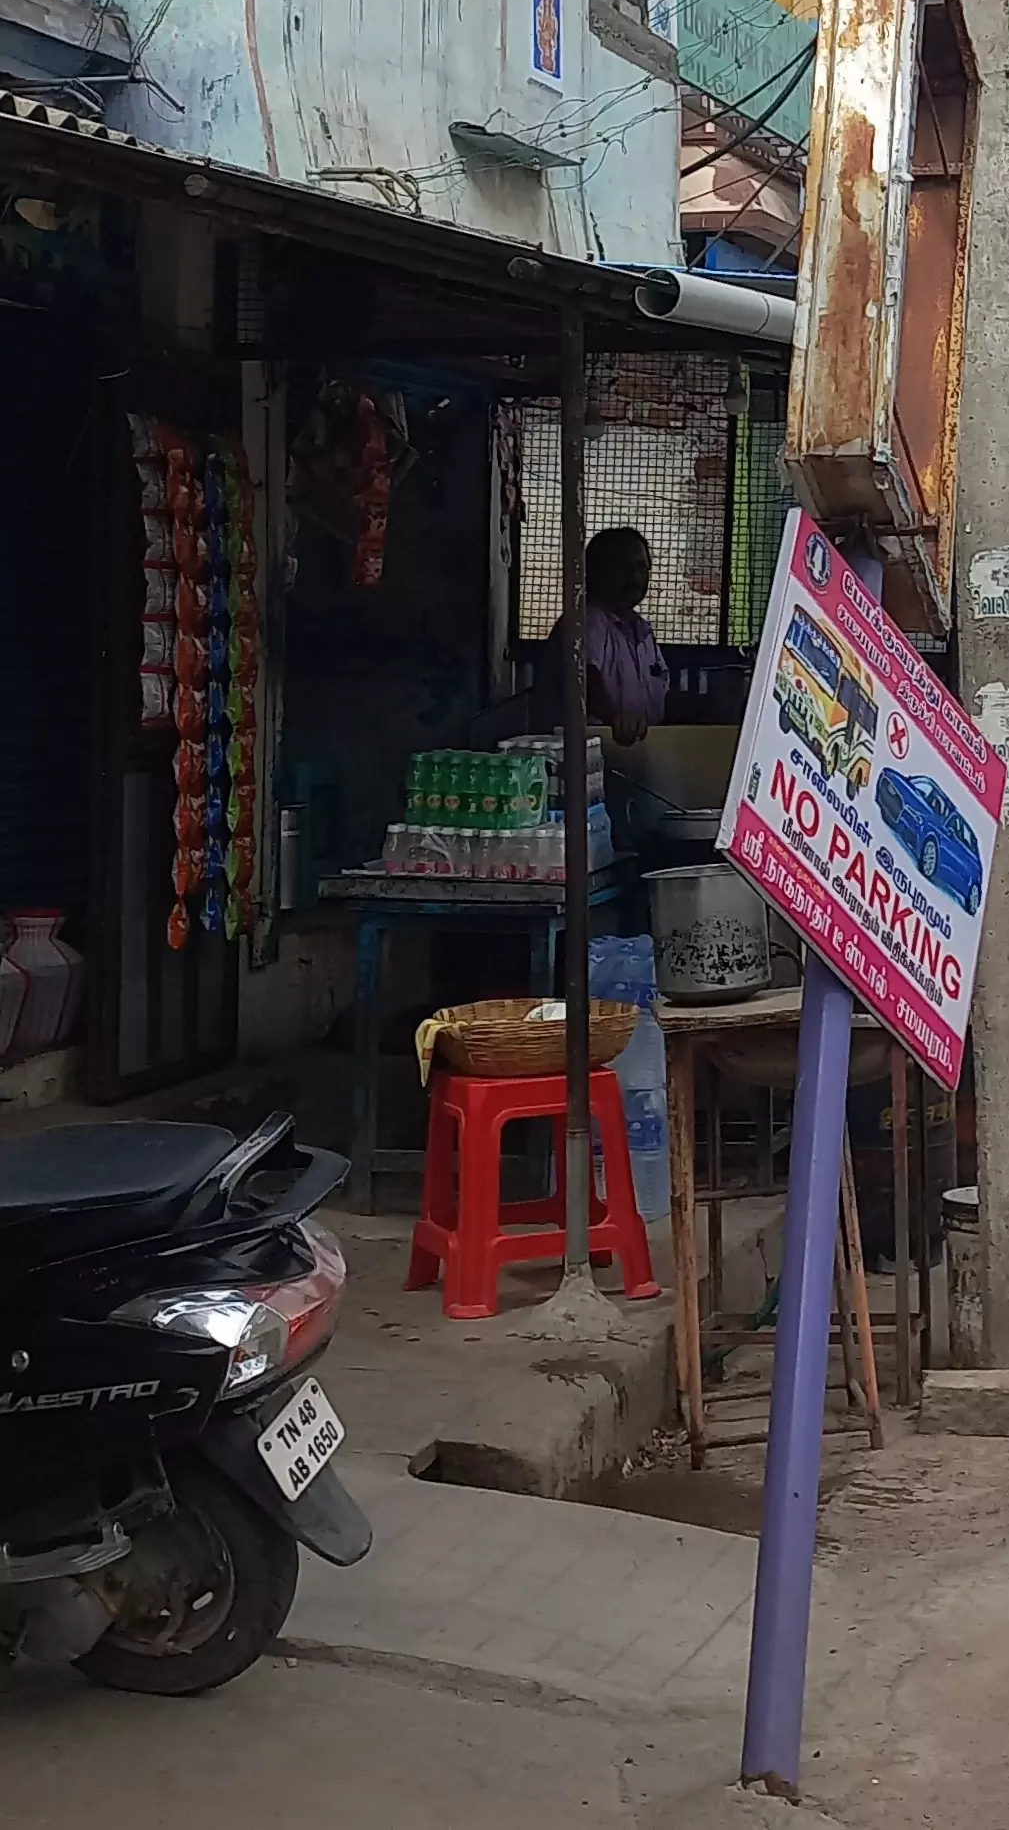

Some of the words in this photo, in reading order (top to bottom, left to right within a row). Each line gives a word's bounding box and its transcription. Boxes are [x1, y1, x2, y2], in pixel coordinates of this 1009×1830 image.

[837, 604, 890, 676] சமயபுரம்
[897, 680, 935, 734] திருச்சி
[935, 724, 985, 792] மாவட்டம்
[843, 570, 942, 712] போக்குவரத்து
[943, 701, 987, 764] காவல்
[742, 829, 764, 869] ஸ்ரீ
[764, 855, 832, 938] நாகநாதர்
[832, 927, 842, 951] டீ
[845, 939, 887, 999] ஸ்டால்
[770, 758, 820, 839] NO
[828, 823, 961, 1002] PARKING
[782, 816, 830, 881] மீறினால்
[832, 874, 880, 938] அபராதம்
[881, 929, 943, 1007] விதிக்கப்படும்
[790, 748, 873, 848] சாலையின்
[875, 846, 952, 939] இருபுறமும்
[276, 1417, 302, 1449] TN
[298, 1398, 317, 1426] 48
[288, 1456, 310, 1491] AB
[308, 1420, 338, 1464] 1650
